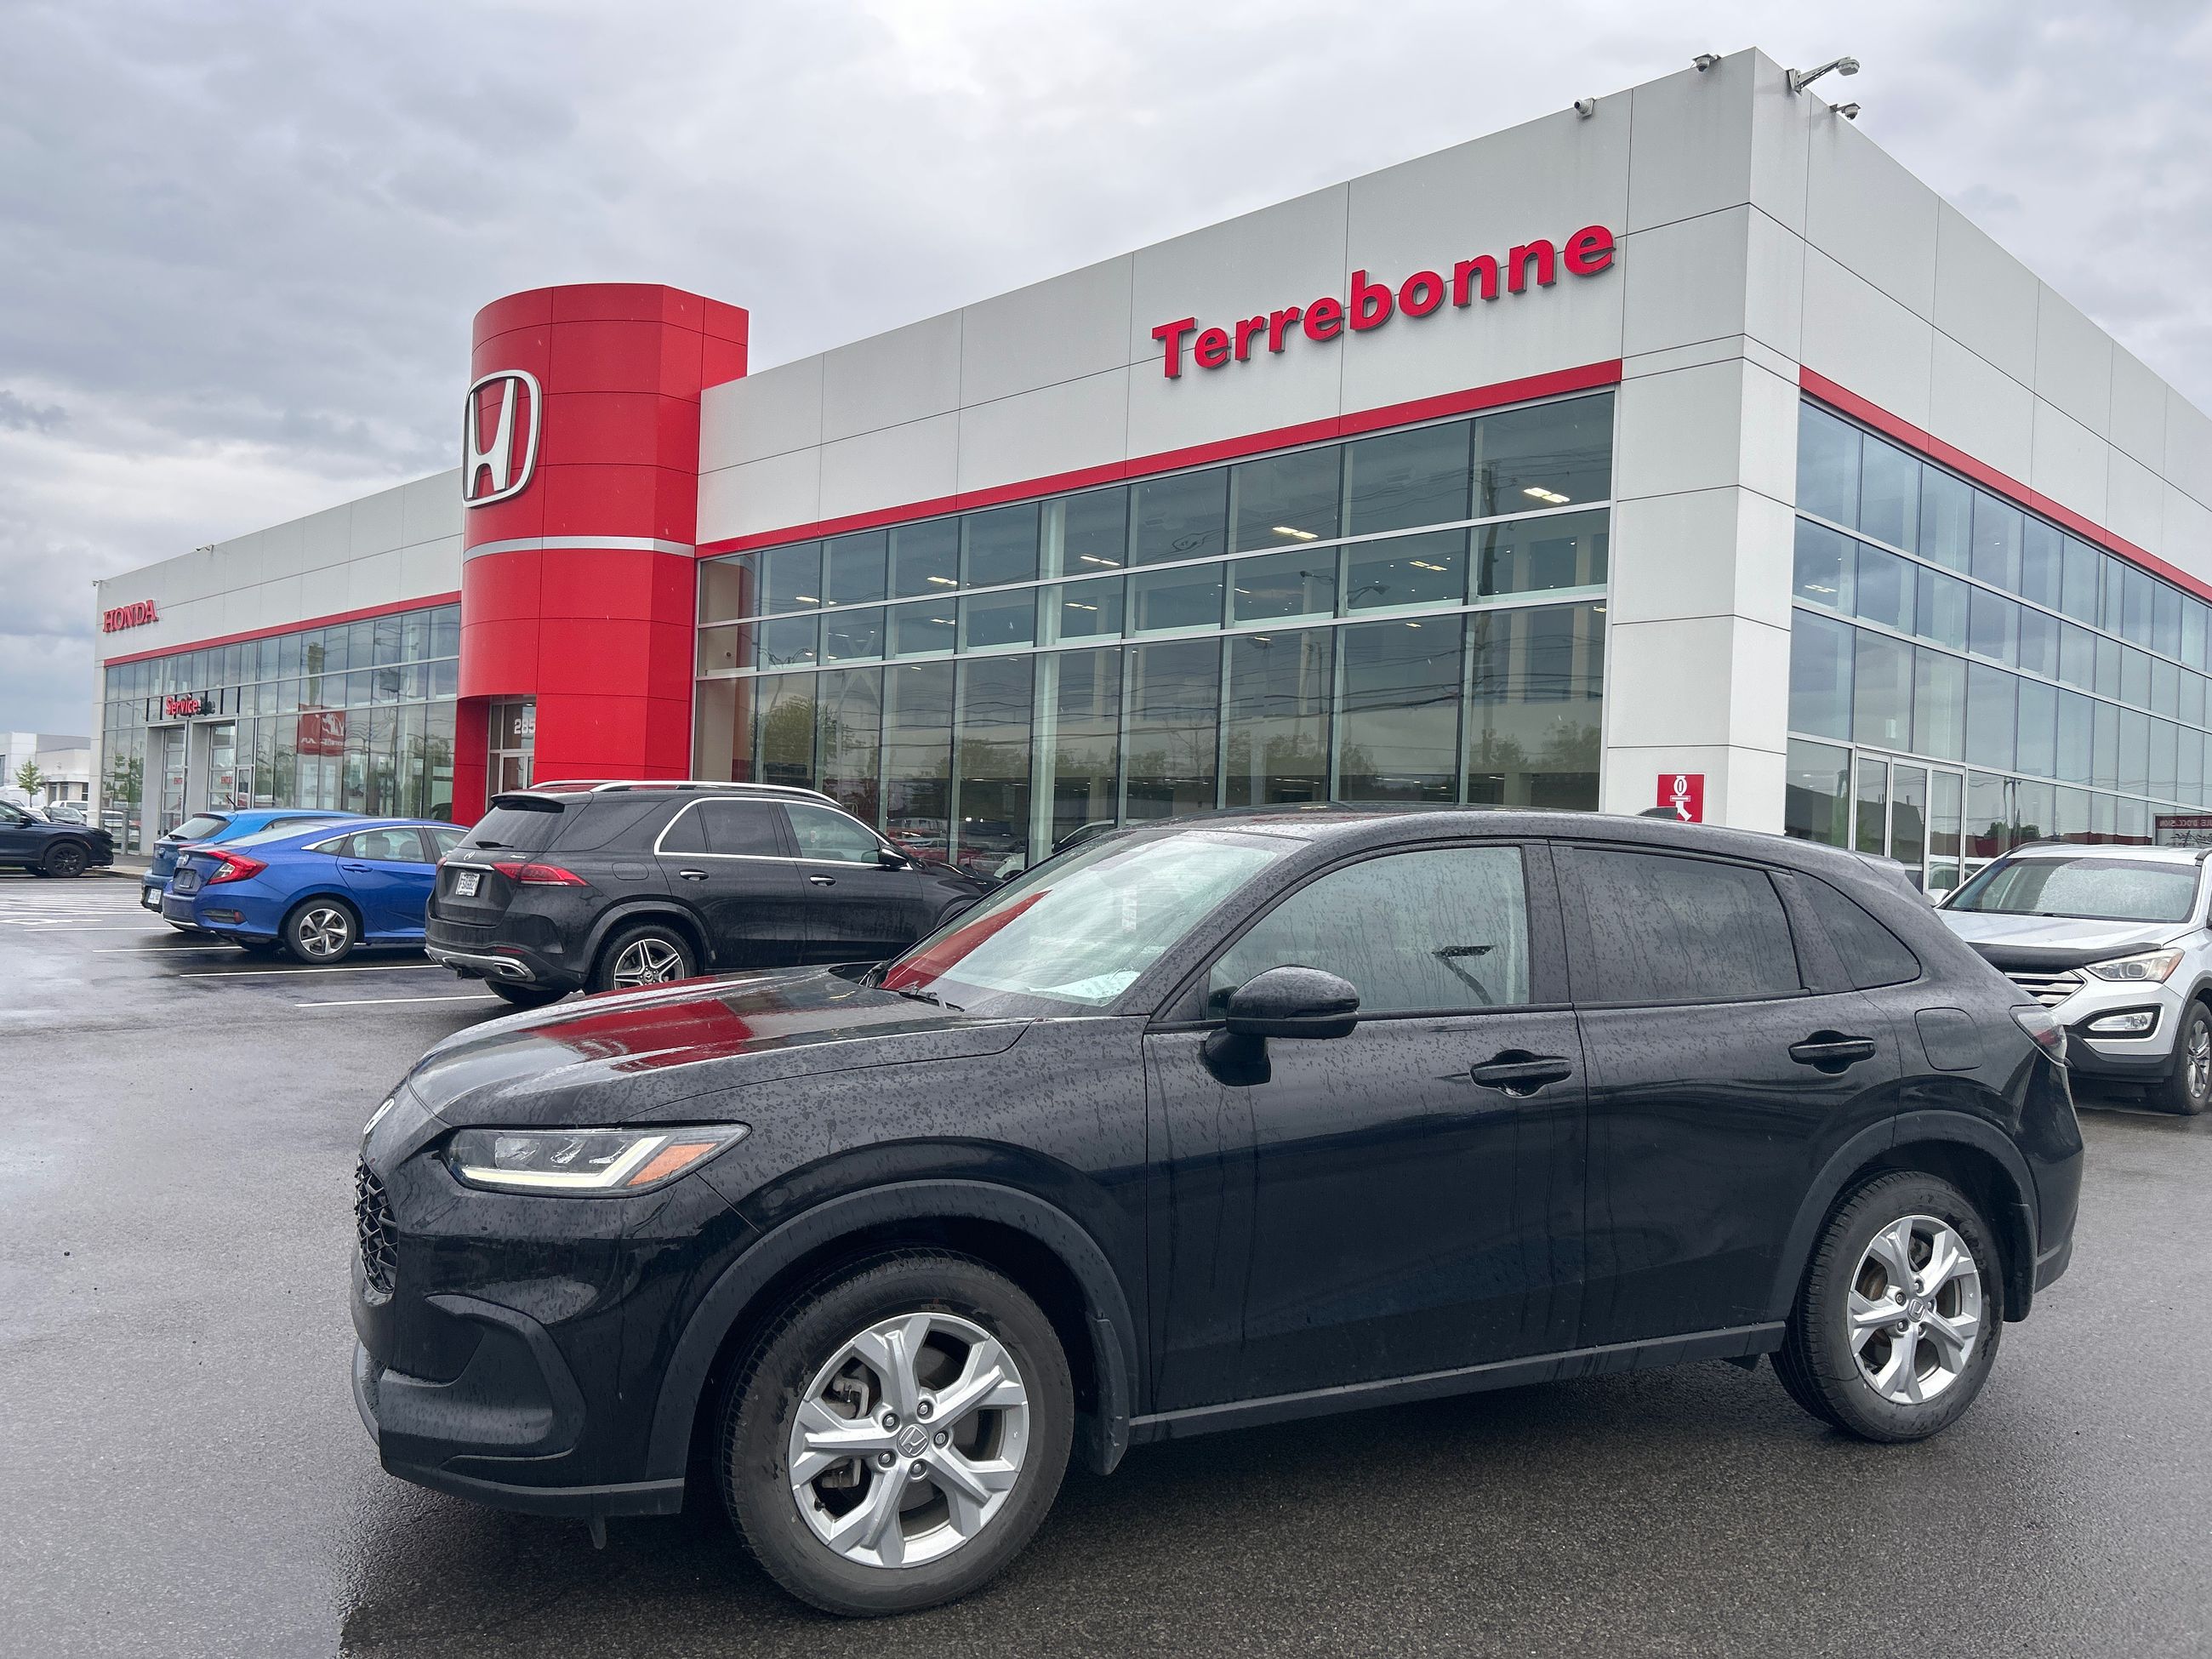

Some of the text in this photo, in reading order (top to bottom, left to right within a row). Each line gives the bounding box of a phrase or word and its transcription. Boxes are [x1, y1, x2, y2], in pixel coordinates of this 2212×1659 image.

[1152, 225, 1616, 379] Terrebonne
[103, 600, 159, 633] HONDA
[166, 694, 200, 715] Service
